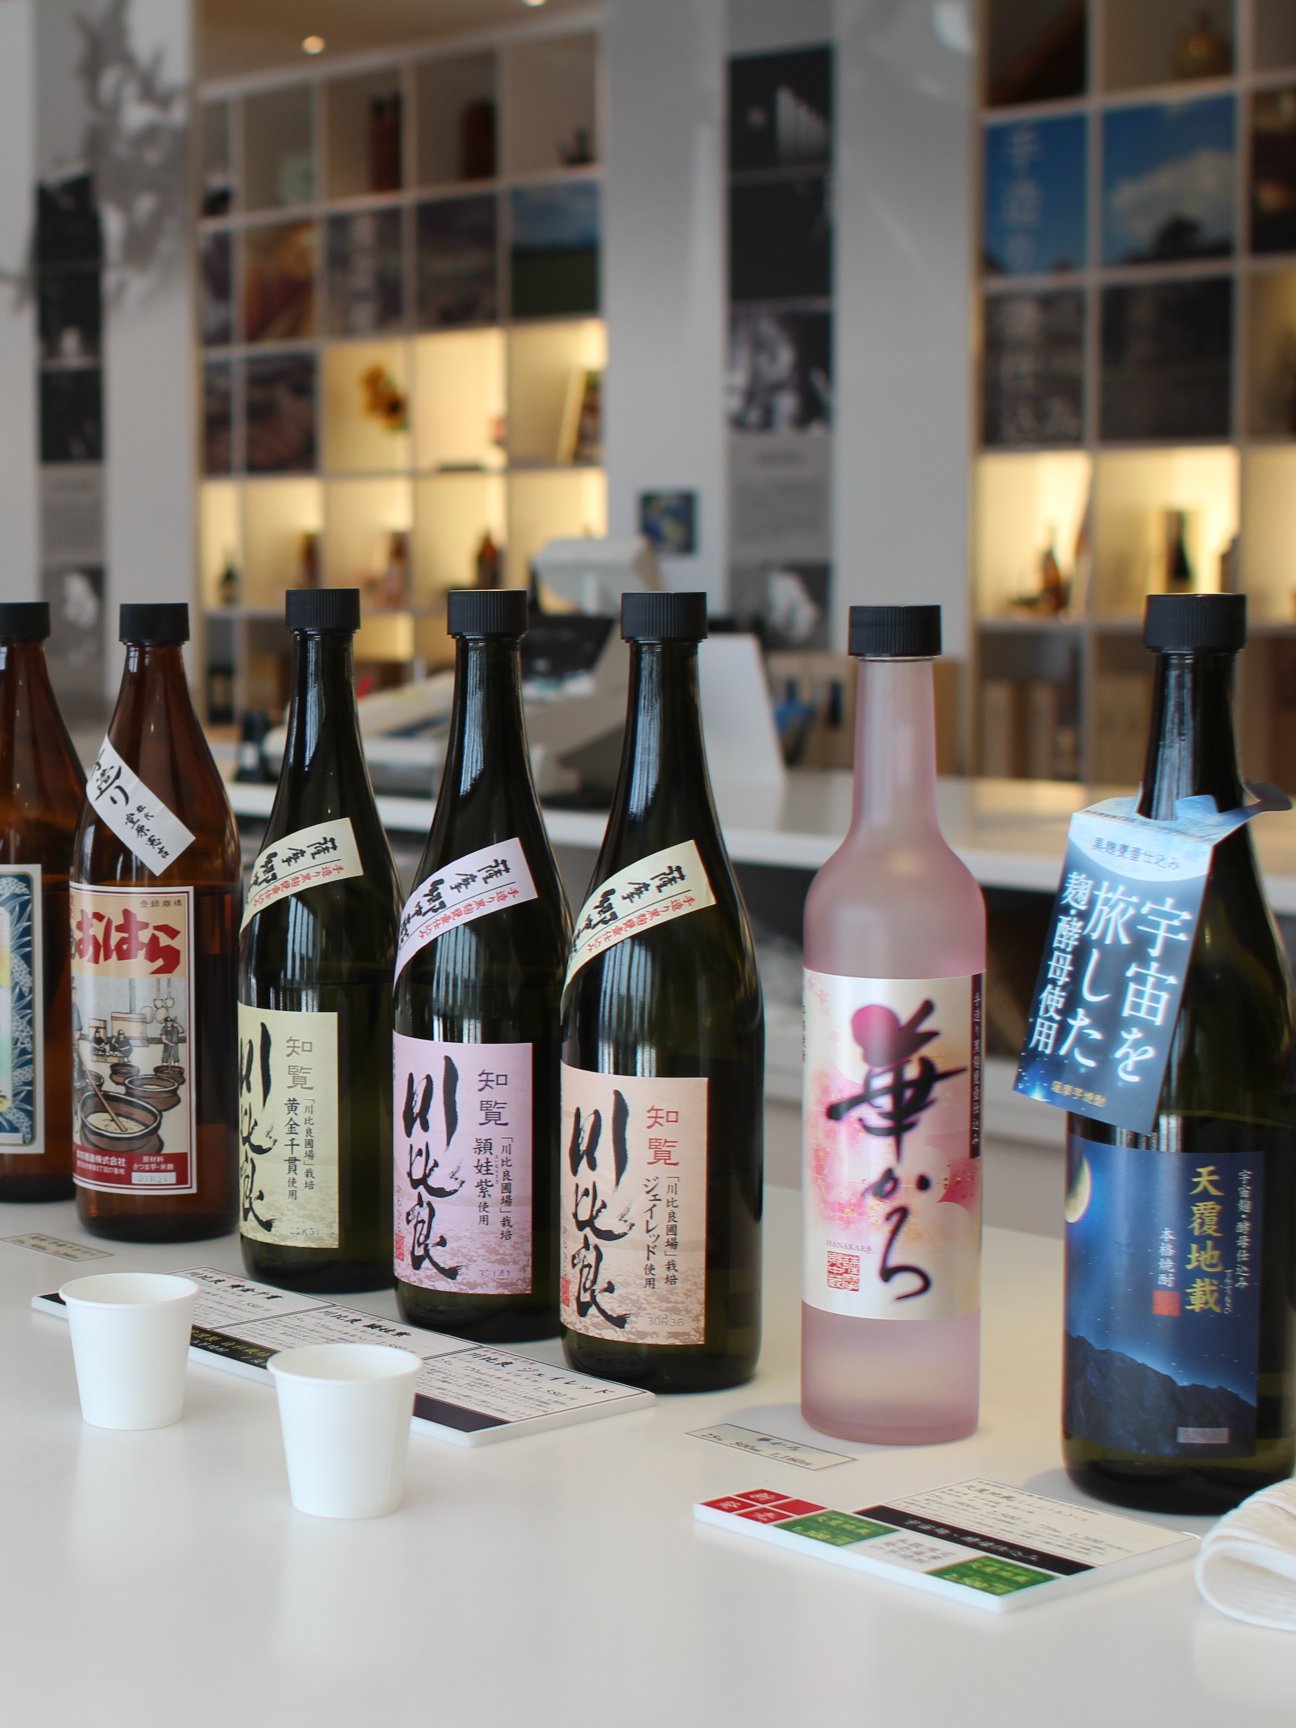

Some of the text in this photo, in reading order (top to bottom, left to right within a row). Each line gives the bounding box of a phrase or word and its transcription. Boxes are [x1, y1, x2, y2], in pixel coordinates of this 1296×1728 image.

[75, 908, 181, 975] おはら
[1058, 879, 1140, 1069] 旅した
[1113, 896, 1193, 1084] 宇宙を
[286, 1036, 314, 1090] 知覧
[477, 1069, 509, 1127] 知覧
[284, 1097, 301, 1201] 黄金千貫使用
[402, 1055, 466, 1281] 川比良
[646, 1105, 679, 1166] 知覧
[569, 1089, 636, 1329] 川比良
[643, 1176, 661, 1289] ジェイレッド使用
[1184, 1165, 1225, 1313] 天覆地載
